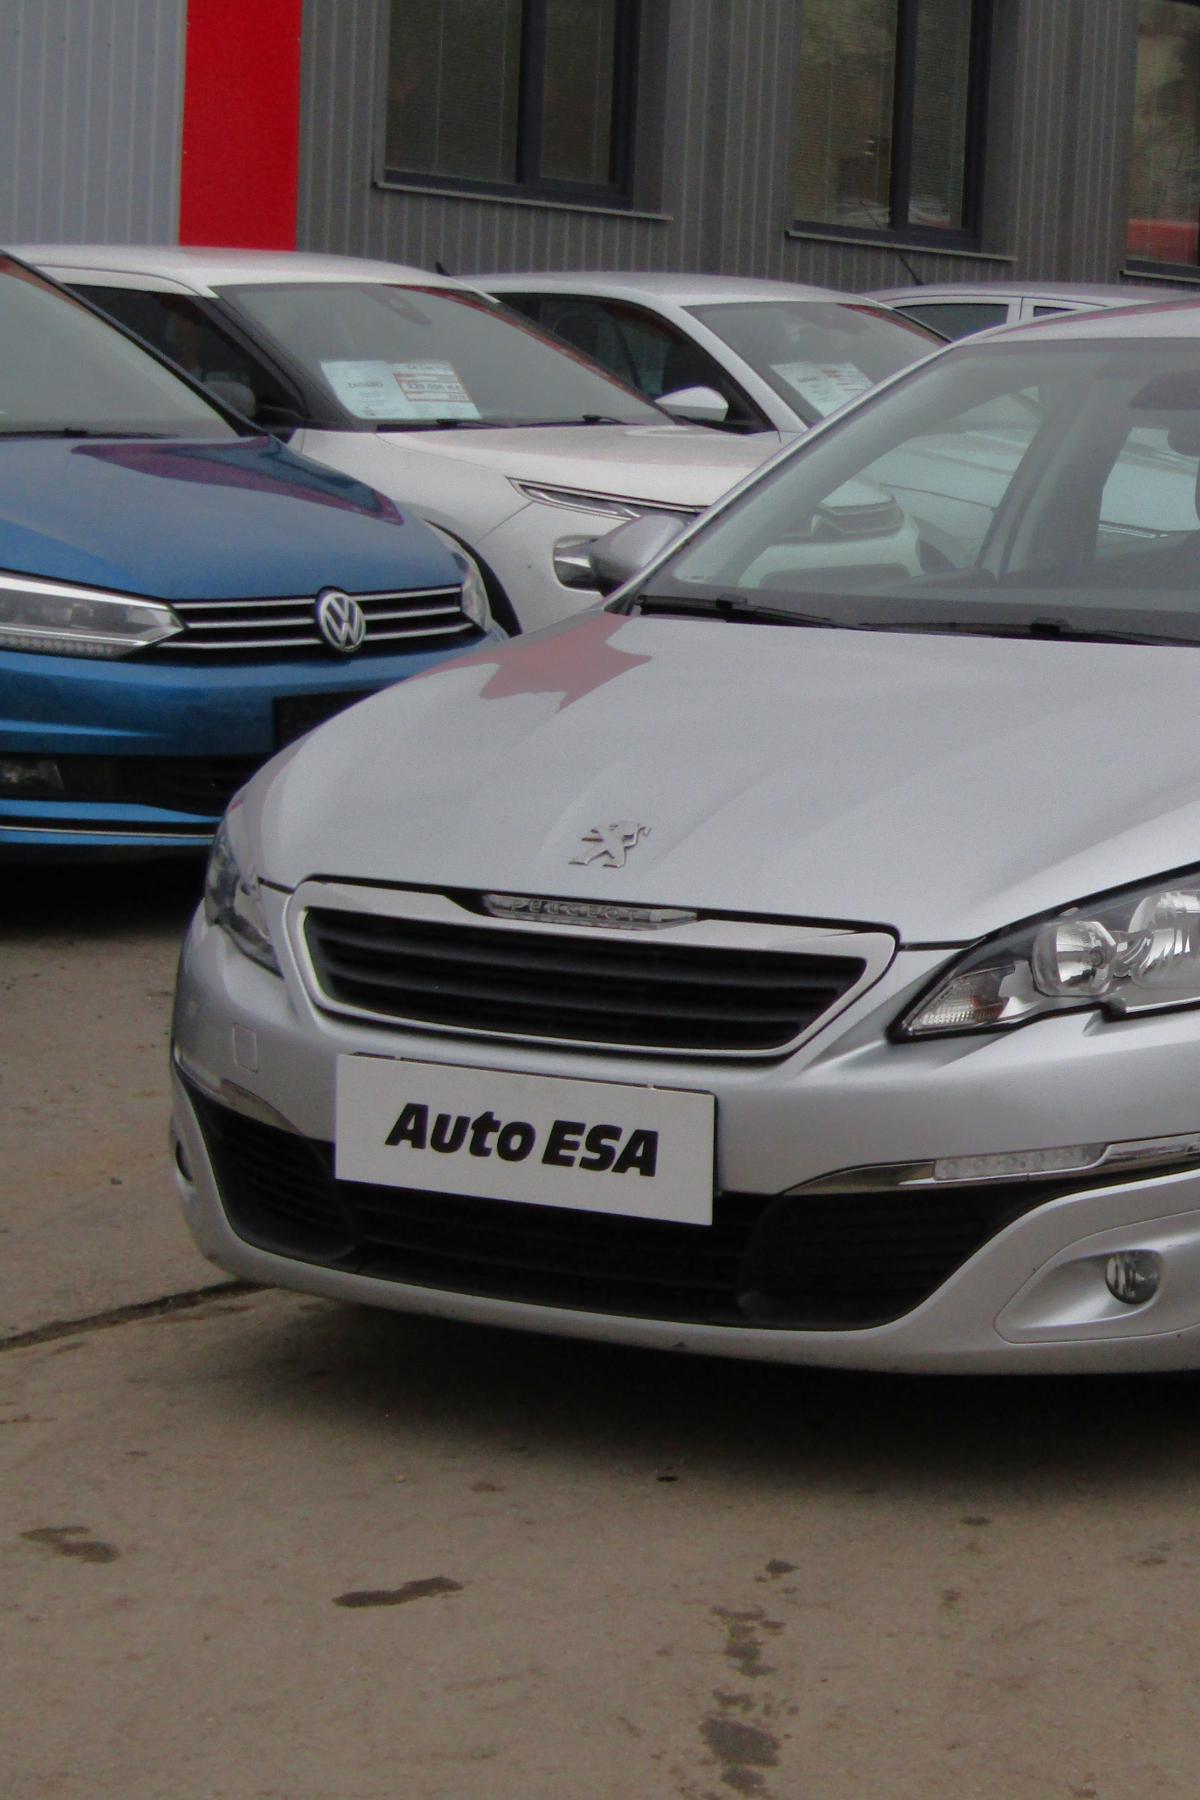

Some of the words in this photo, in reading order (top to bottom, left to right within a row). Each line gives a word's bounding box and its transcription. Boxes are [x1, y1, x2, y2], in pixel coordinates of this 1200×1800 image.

[510, 897, 639, 923] PEUGEOT
[384, 1102, 536, 1162] Auto
[541, 1119, 659, 1178] ESA
